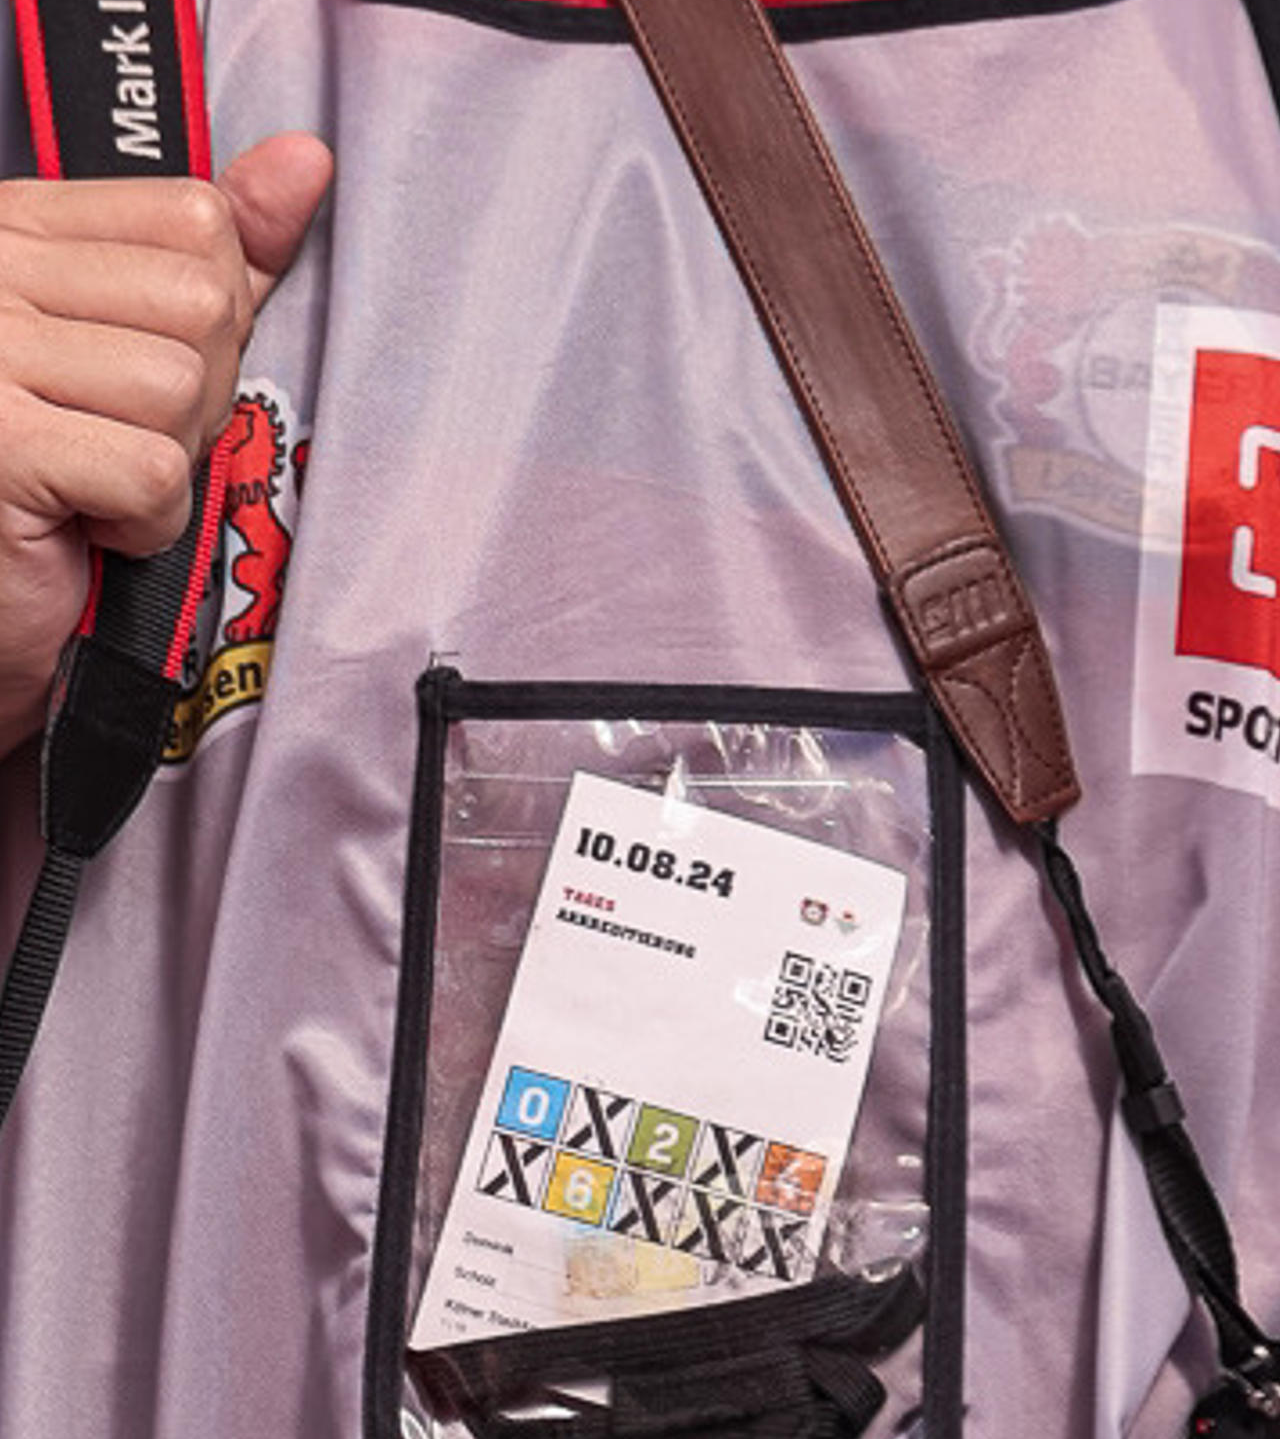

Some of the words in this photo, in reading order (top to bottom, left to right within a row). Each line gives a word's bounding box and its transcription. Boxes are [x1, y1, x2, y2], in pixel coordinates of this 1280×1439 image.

[100, 22, 162, 160] Mark
[574, 827, 736, 898] 10.08.24
[519, 1087, 550, 1126] 0
[645, 1123, 680, 1163] 2
